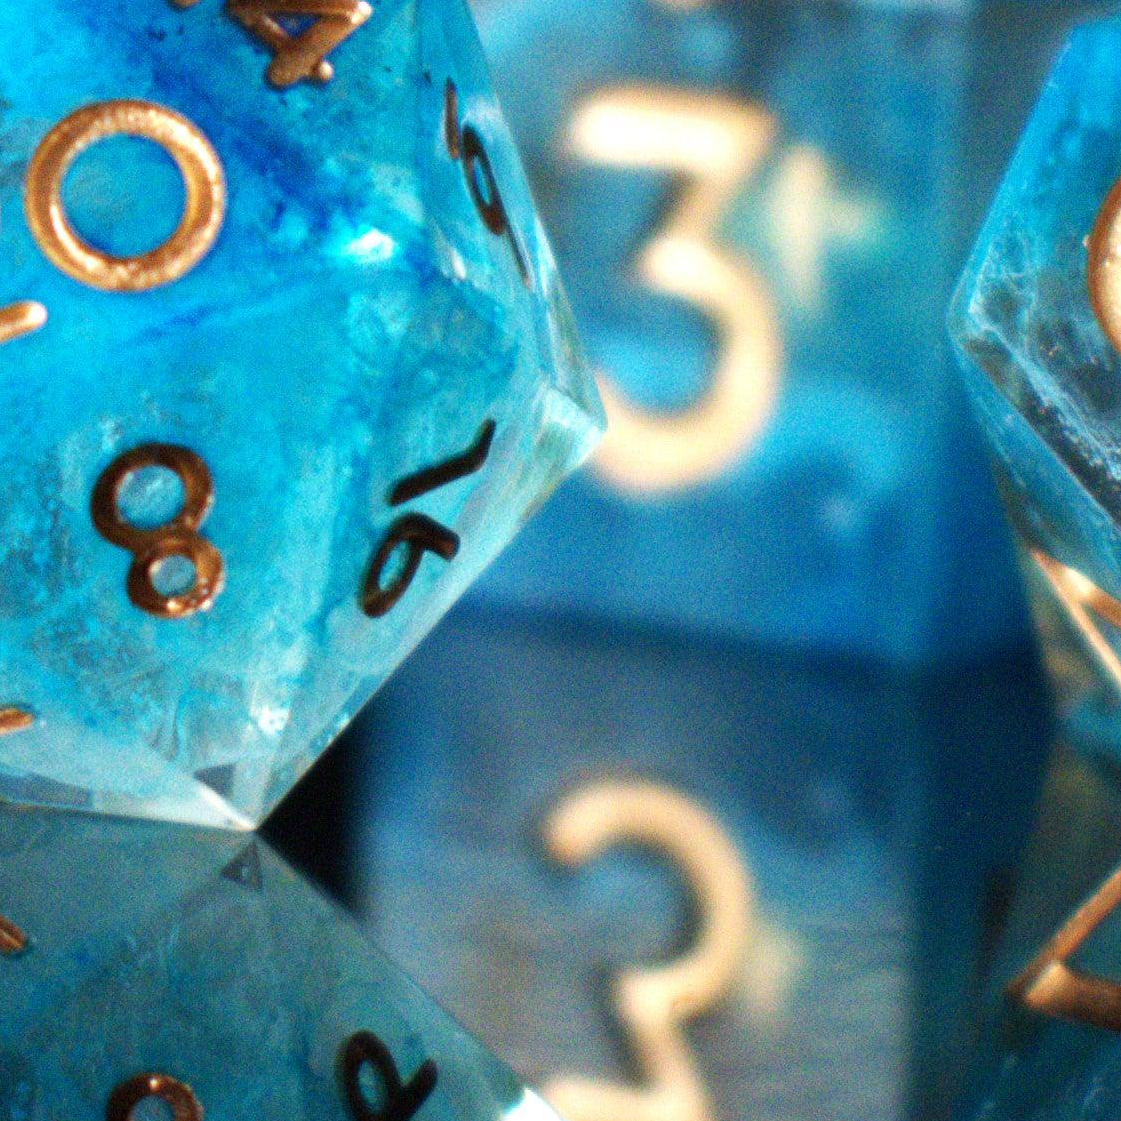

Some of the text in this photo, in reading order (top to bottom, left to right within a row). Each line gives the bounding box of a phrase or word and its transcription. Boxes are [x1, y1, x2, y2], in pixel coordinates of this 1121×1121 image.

[569, 89, 785, 501] 3
[89, 441, 226, 620] 8
[356, 418, 497, 619] 16
